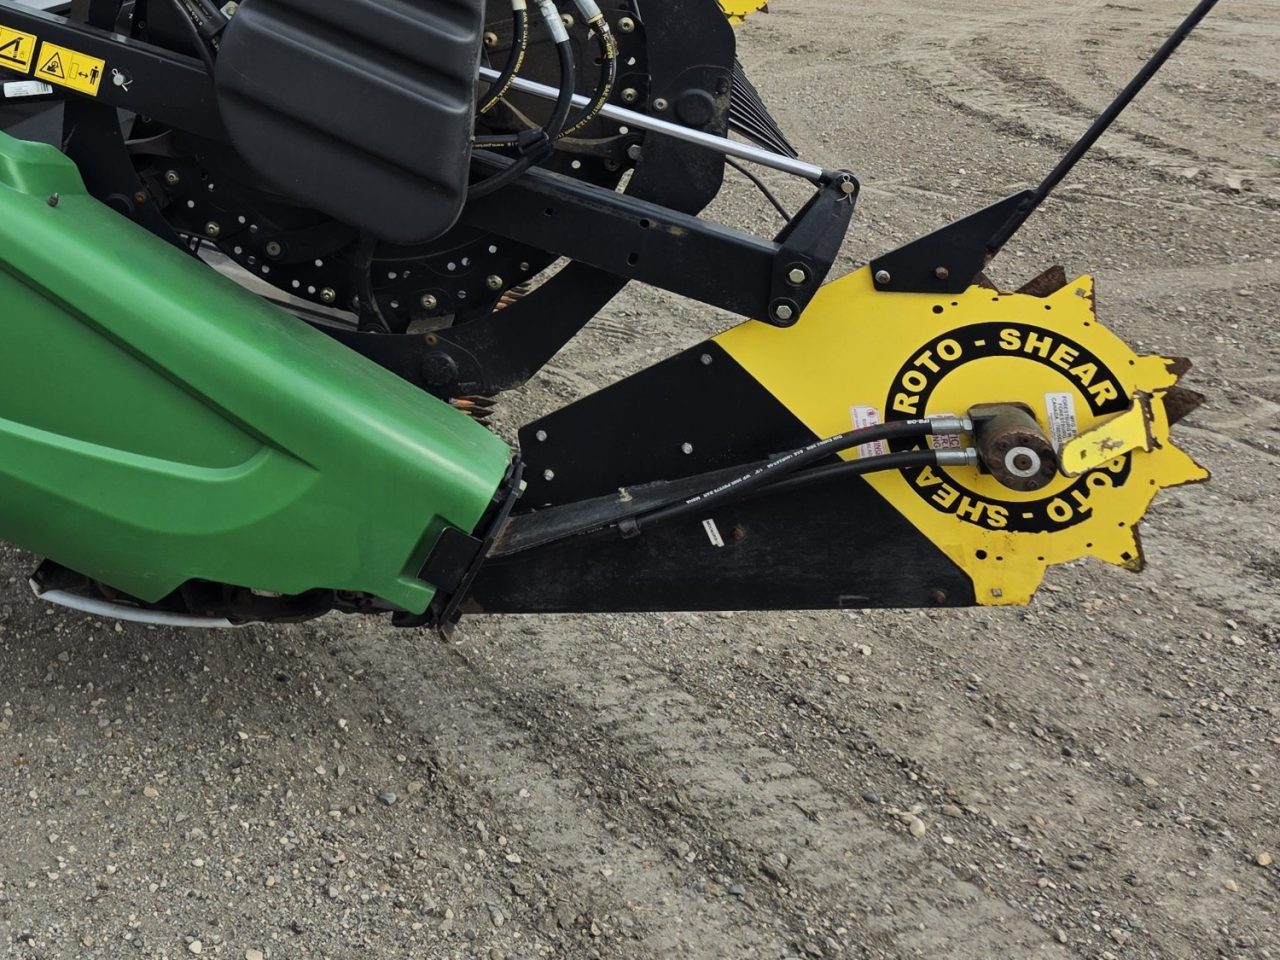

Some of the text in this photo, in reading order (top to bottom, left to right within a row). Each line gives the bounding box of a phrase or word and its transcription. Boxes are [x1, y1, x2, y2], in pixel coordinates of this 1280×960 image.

[893, 338, 963, 415] ROTO
[999, 328, 1118, 407] SHEAR
[903, 446, 1009, 527] SHEA
